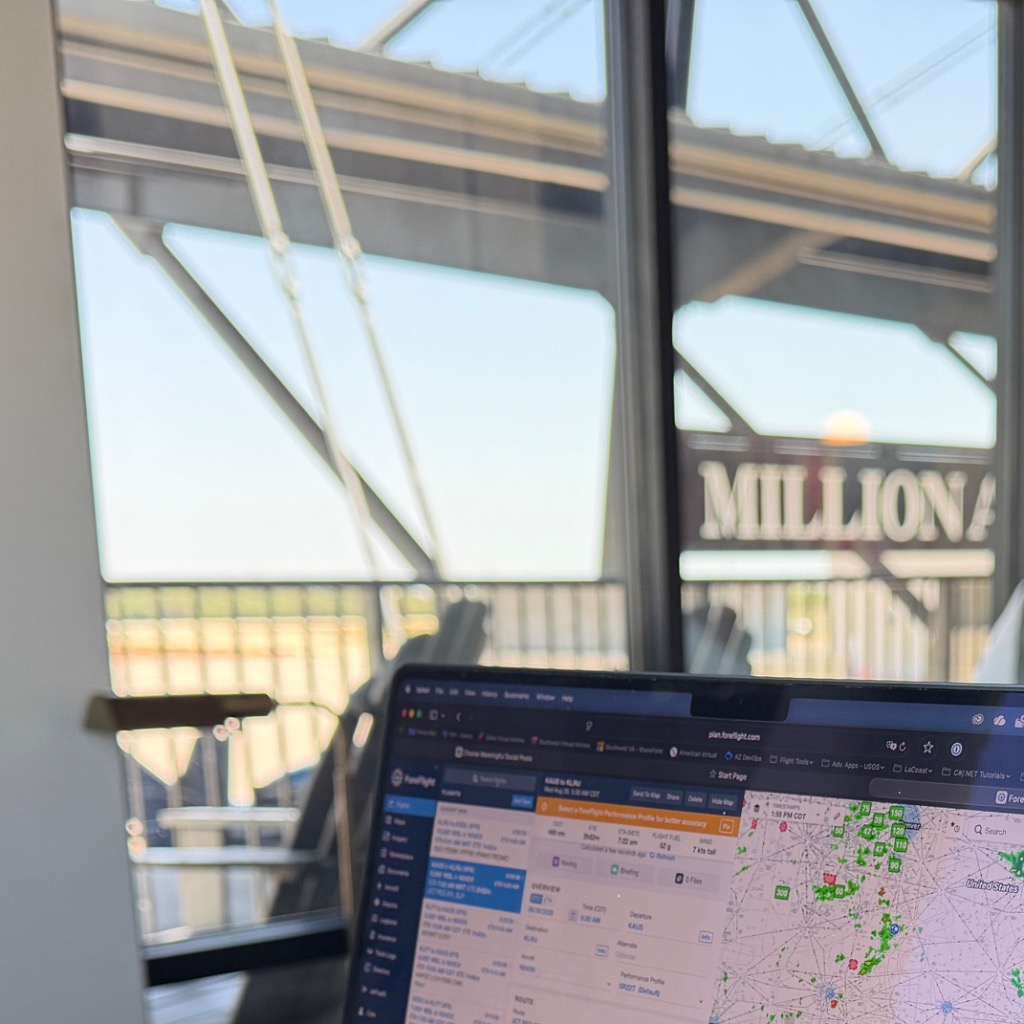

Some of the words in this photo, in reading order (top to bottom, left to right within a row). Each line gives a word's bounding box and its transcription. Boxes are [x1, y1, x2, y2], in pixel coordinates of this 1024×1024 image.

[698, 460, 967, 542] MILLION
[708, 730, 761, 742] plan.foreflight.com
[845, 762, 858, 771] Apps
[864, 763, 881, 771] USGS
[904, 766, 928, 774] LaCoast
[718, 770, 732, 780] Start
[732, 772, 747, 782] Page
[980, 771, 1005, 780] Tutorials
[794, 812, 806, 821] CDT
[984, 826, 1007, 836] Search
[965, 878, 992, 891] United
[992, 881, 1019, 894] States
[629, 911, 652, 921] Departure
